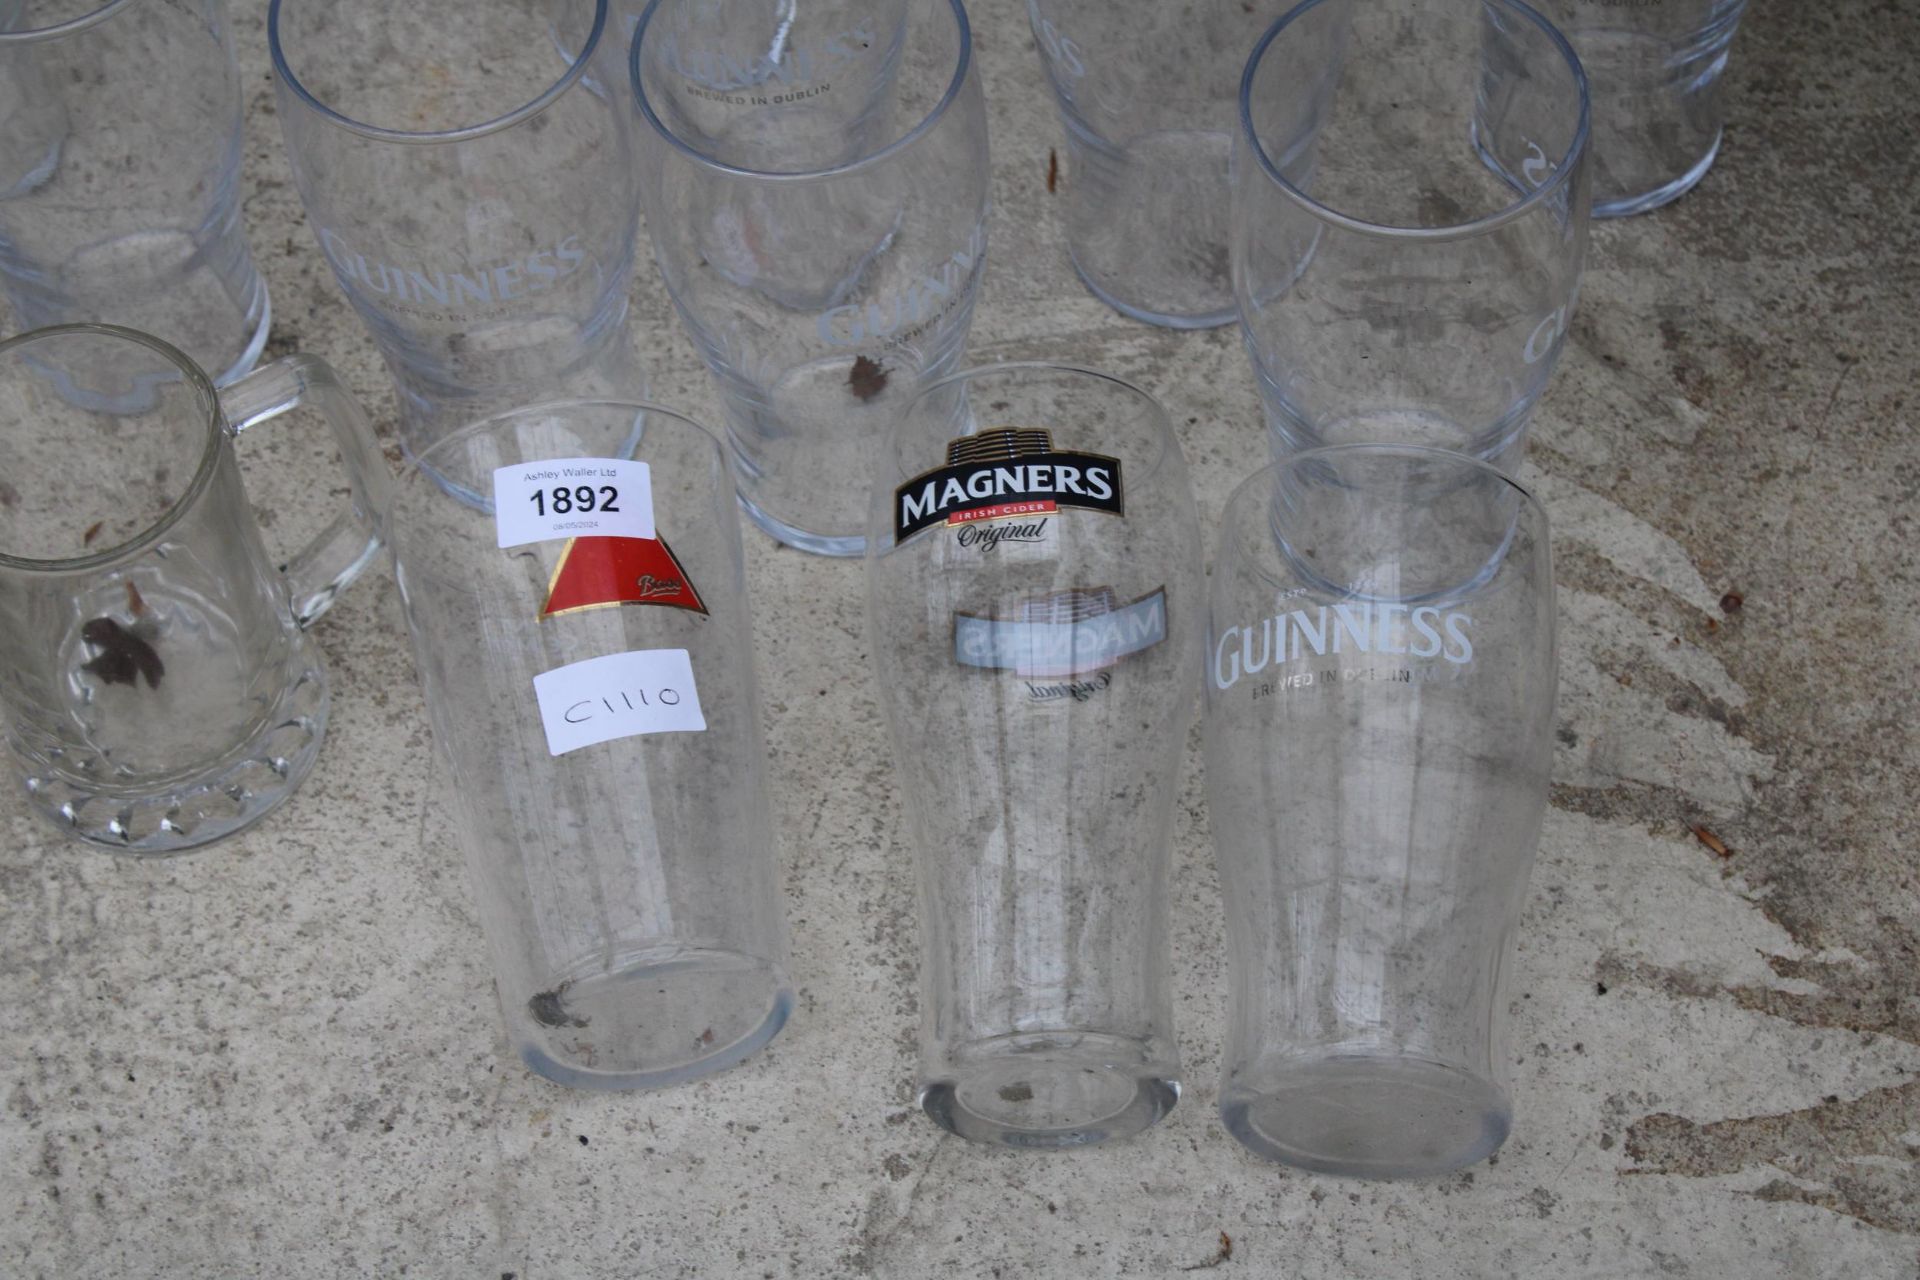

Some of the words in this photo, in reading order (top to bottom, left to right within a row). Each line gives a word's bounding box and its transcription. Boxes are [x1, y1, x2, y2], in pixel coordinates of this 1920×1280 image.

[686, 85, 745, 105] BREWED
[751, 96, 768, 105] IN
[773, 83, 831, 104] DUBLIN
[524, 469, 560, 481] Ashley
[562, 468, 597, 478] Waller
[600, 467, 617, 477] Ltd
[530, 485, 620, 517] 1892
[901, 464, 1113, 529] MAGNERS
[959, 508, 997, 521] IRISH
[1003, 503, 1046, 514] CIDER
[957, 517, 1048, 552] Original
[1214, 602, 1474, 690] GUINNESS
[1320, 669, 1337, 684] IN
[563, 688, 681, 724] C1110
